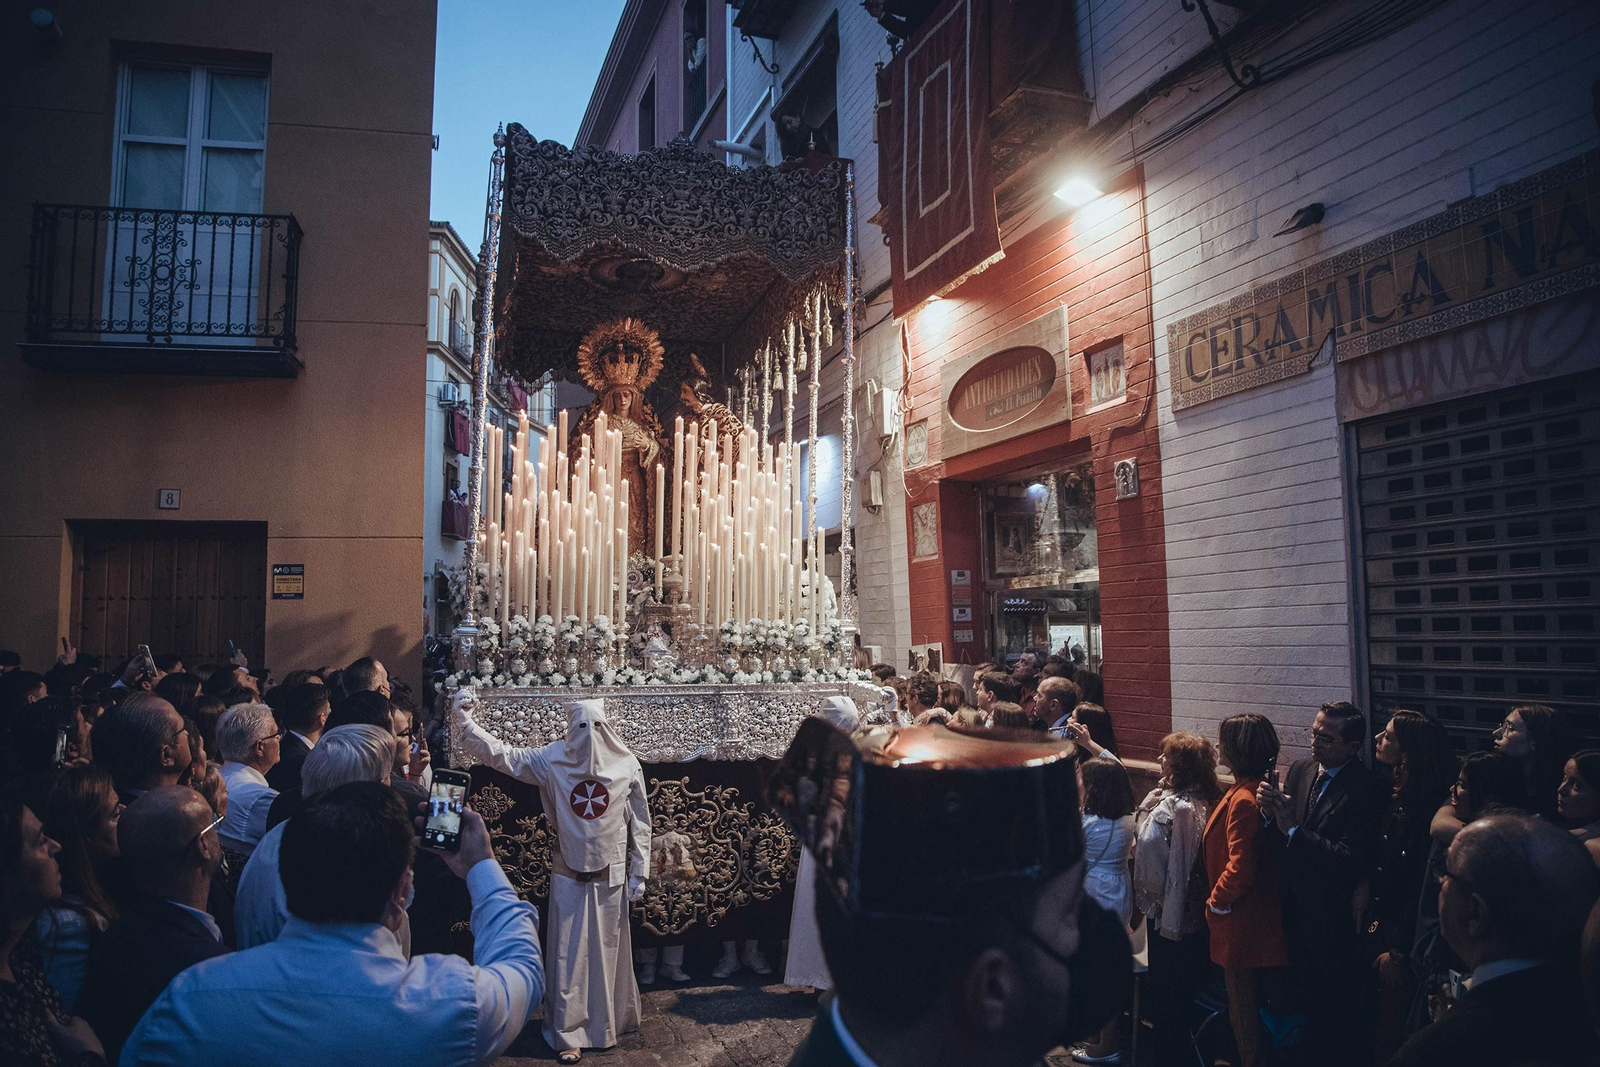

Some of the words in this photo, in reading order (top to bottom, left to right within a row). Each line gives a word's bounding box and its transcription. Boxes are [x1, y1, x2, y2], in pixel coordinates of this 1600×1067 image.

[1185, 249, 1451, 384] CERAMICA
[963, 355, 1042, 411] ANTIGÜEDADES
[166, 492, 174, 505] 8
